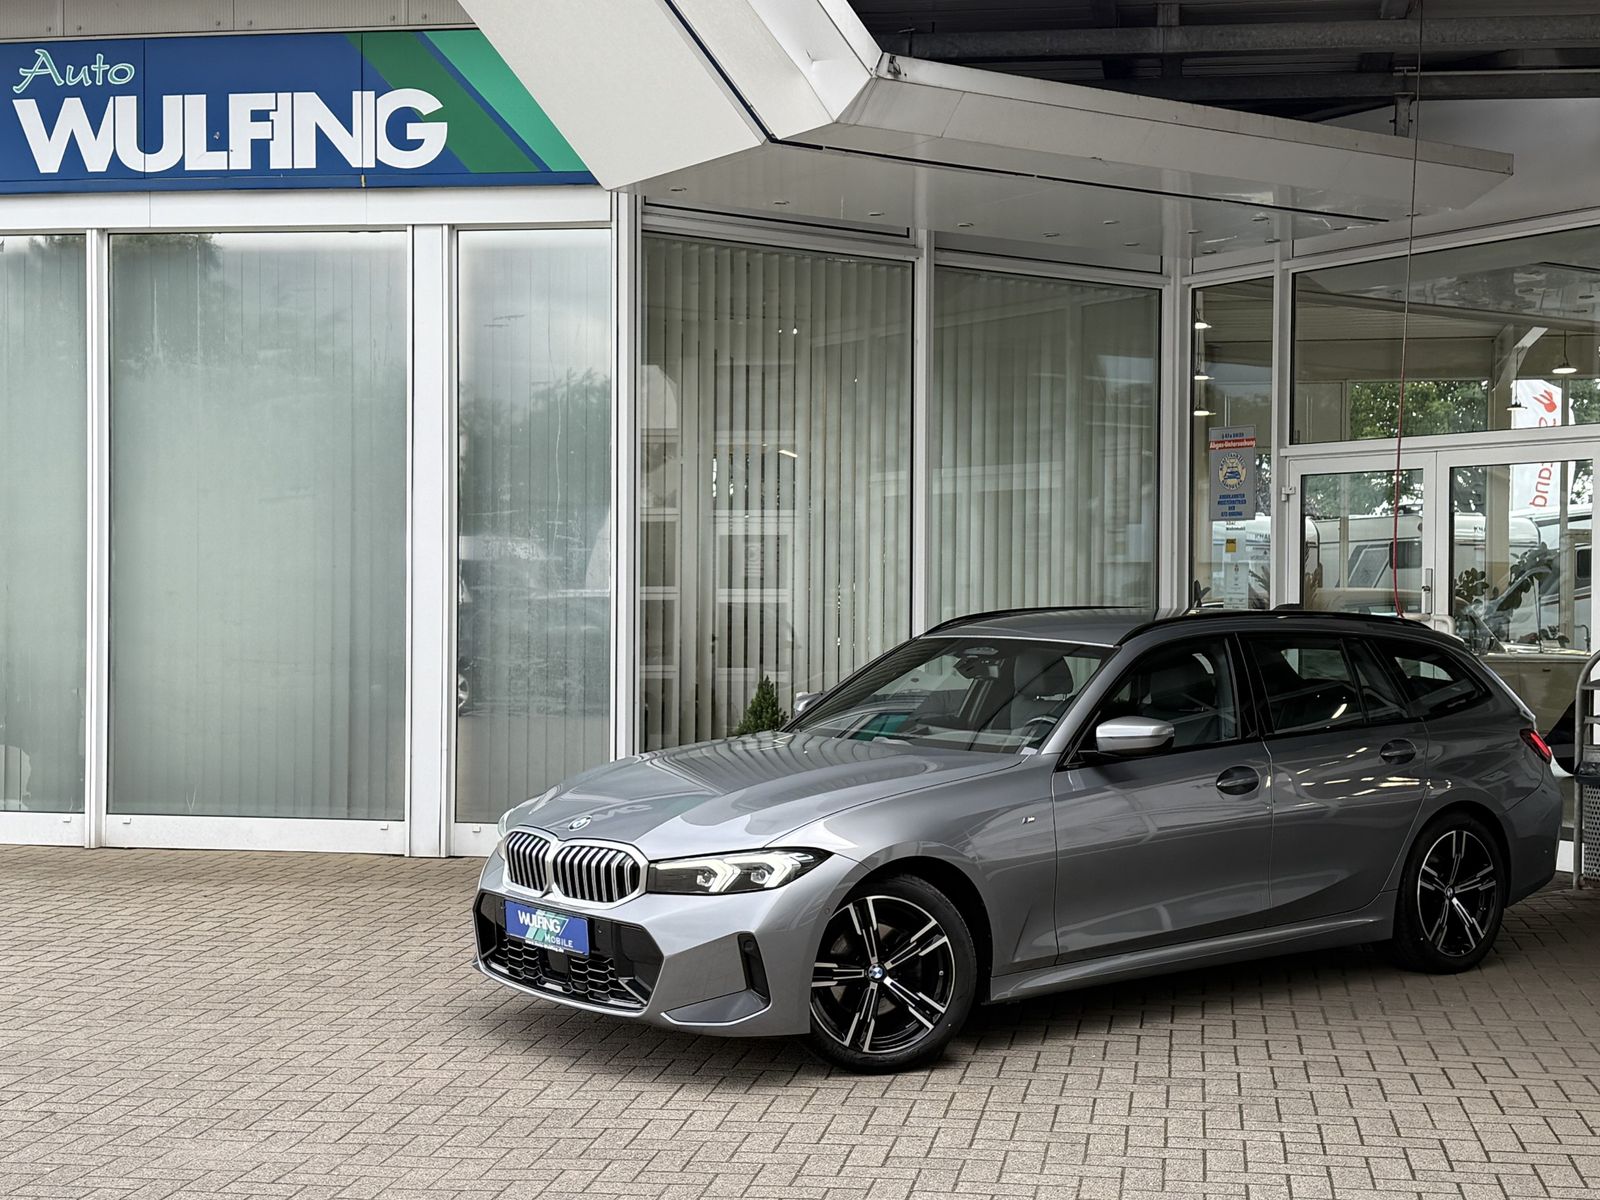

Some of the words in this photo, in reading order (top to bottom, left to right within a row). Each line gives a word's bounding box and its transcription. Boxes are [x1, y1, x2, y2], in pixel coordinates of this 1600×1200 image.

[13, 48, 135, 94] Auto
[12, 88, 448, 174] WULFING
[517, 909, 561, 934] WULFING
[544, 932, 573, 949] MOBILE
